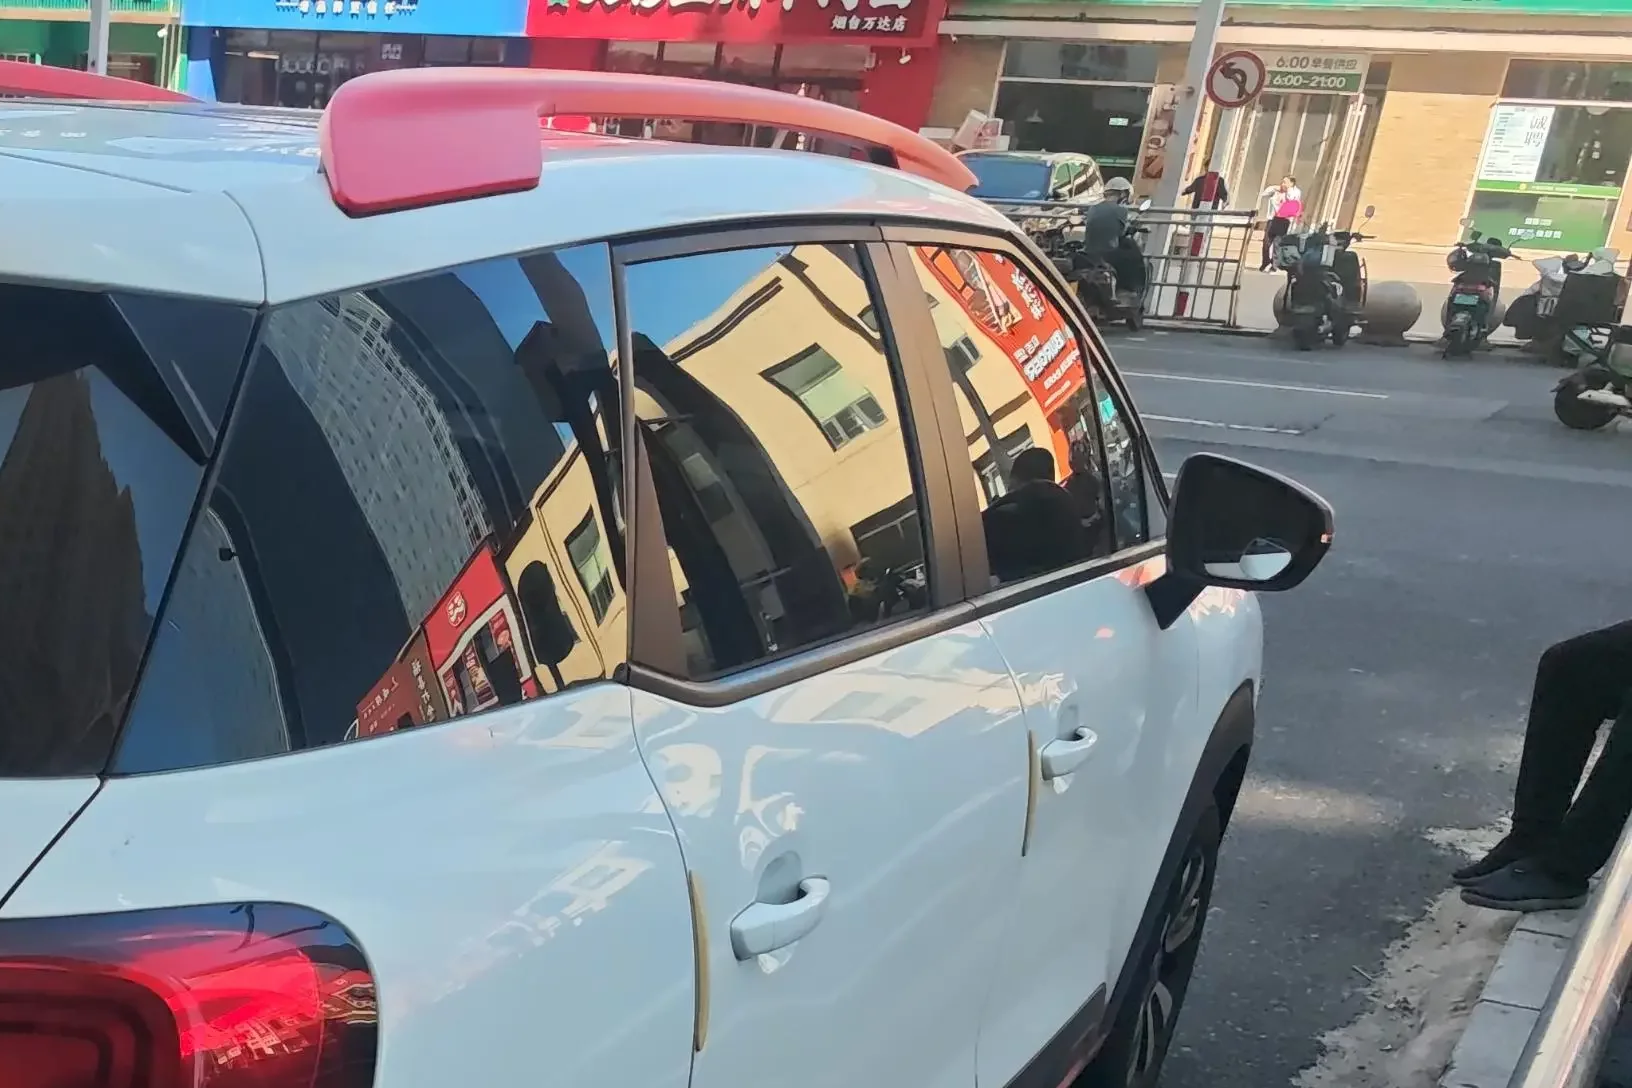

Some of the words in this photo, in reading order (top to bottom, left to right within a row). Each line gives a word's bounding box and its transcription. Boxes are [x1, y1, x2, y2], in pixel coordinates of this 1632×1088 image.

[830, 14, 908, 32] 烟台万达店
